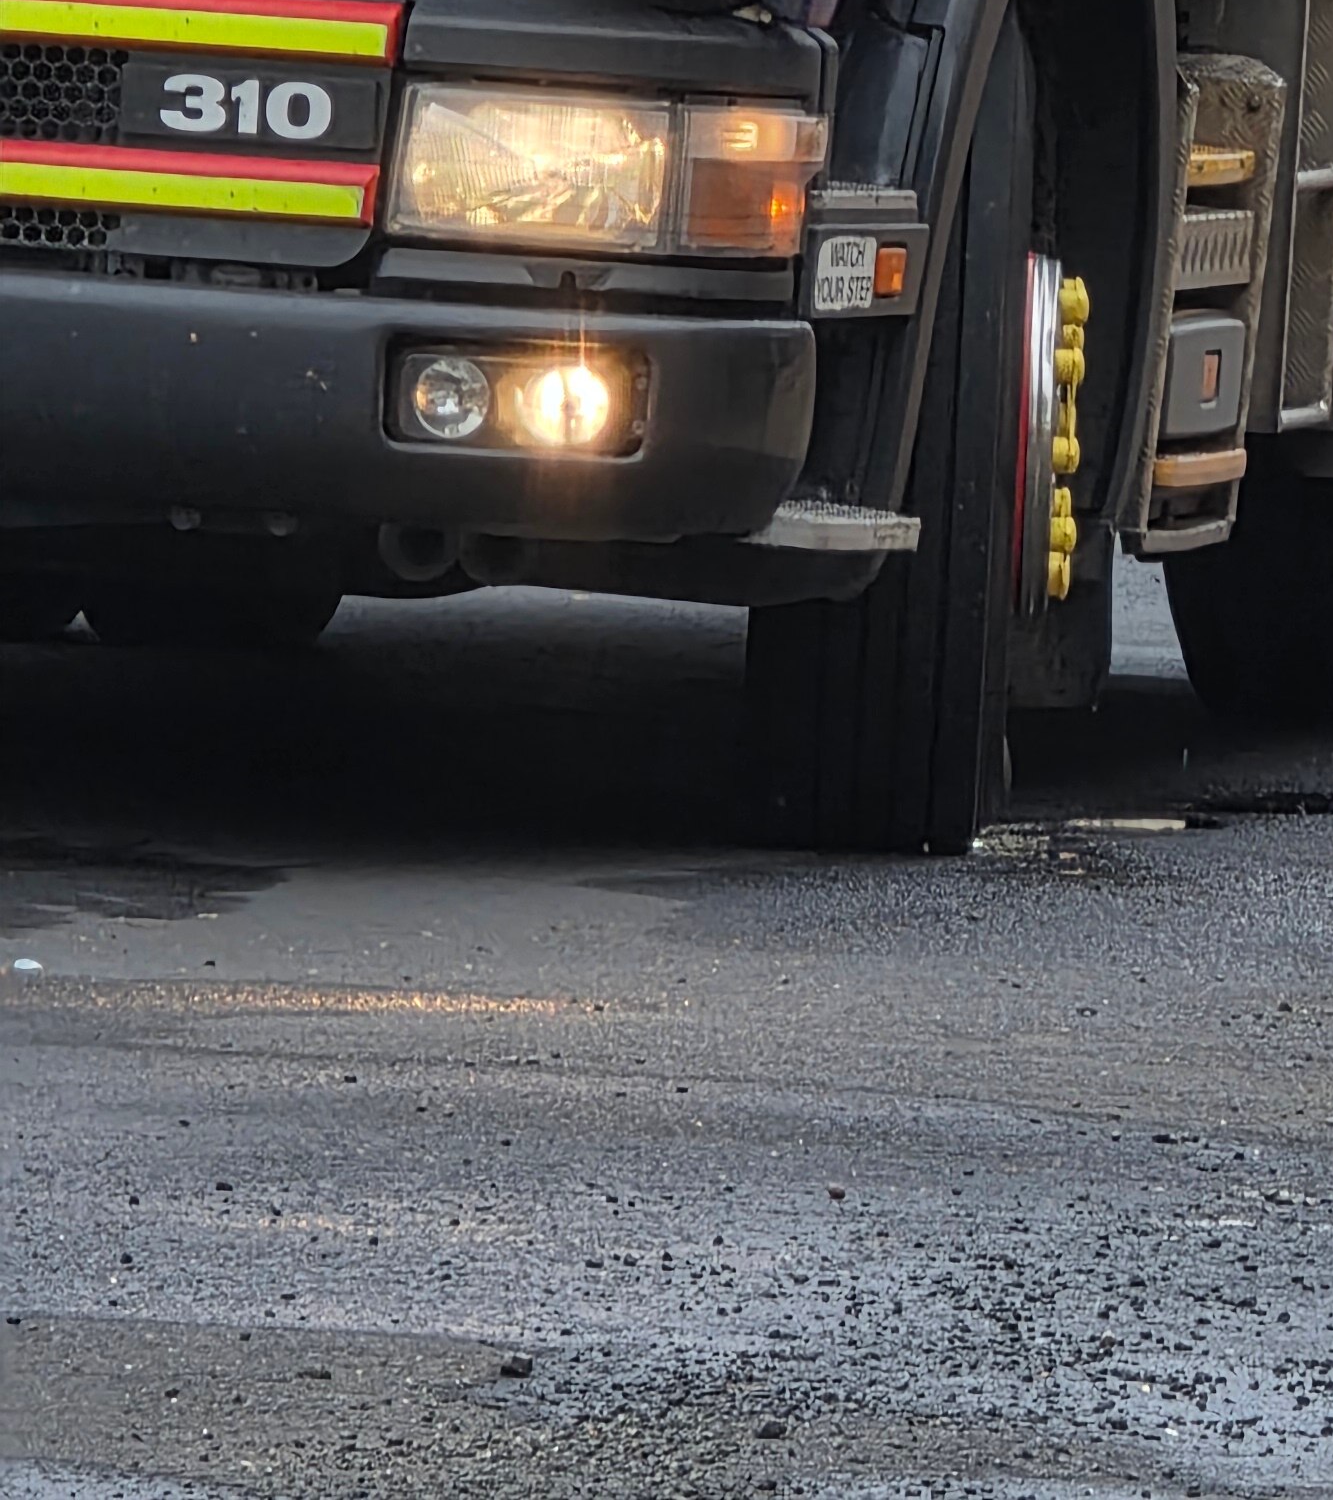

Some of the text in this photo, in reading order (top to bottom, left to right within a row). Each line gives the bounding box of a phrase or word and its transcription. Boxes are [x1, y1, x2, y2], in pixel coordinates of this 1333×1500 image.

[160, 73, 332, 140] 310
[830, 241, 867, 268] WATCH
[816, 276, 873, 304] YOUR STEP
